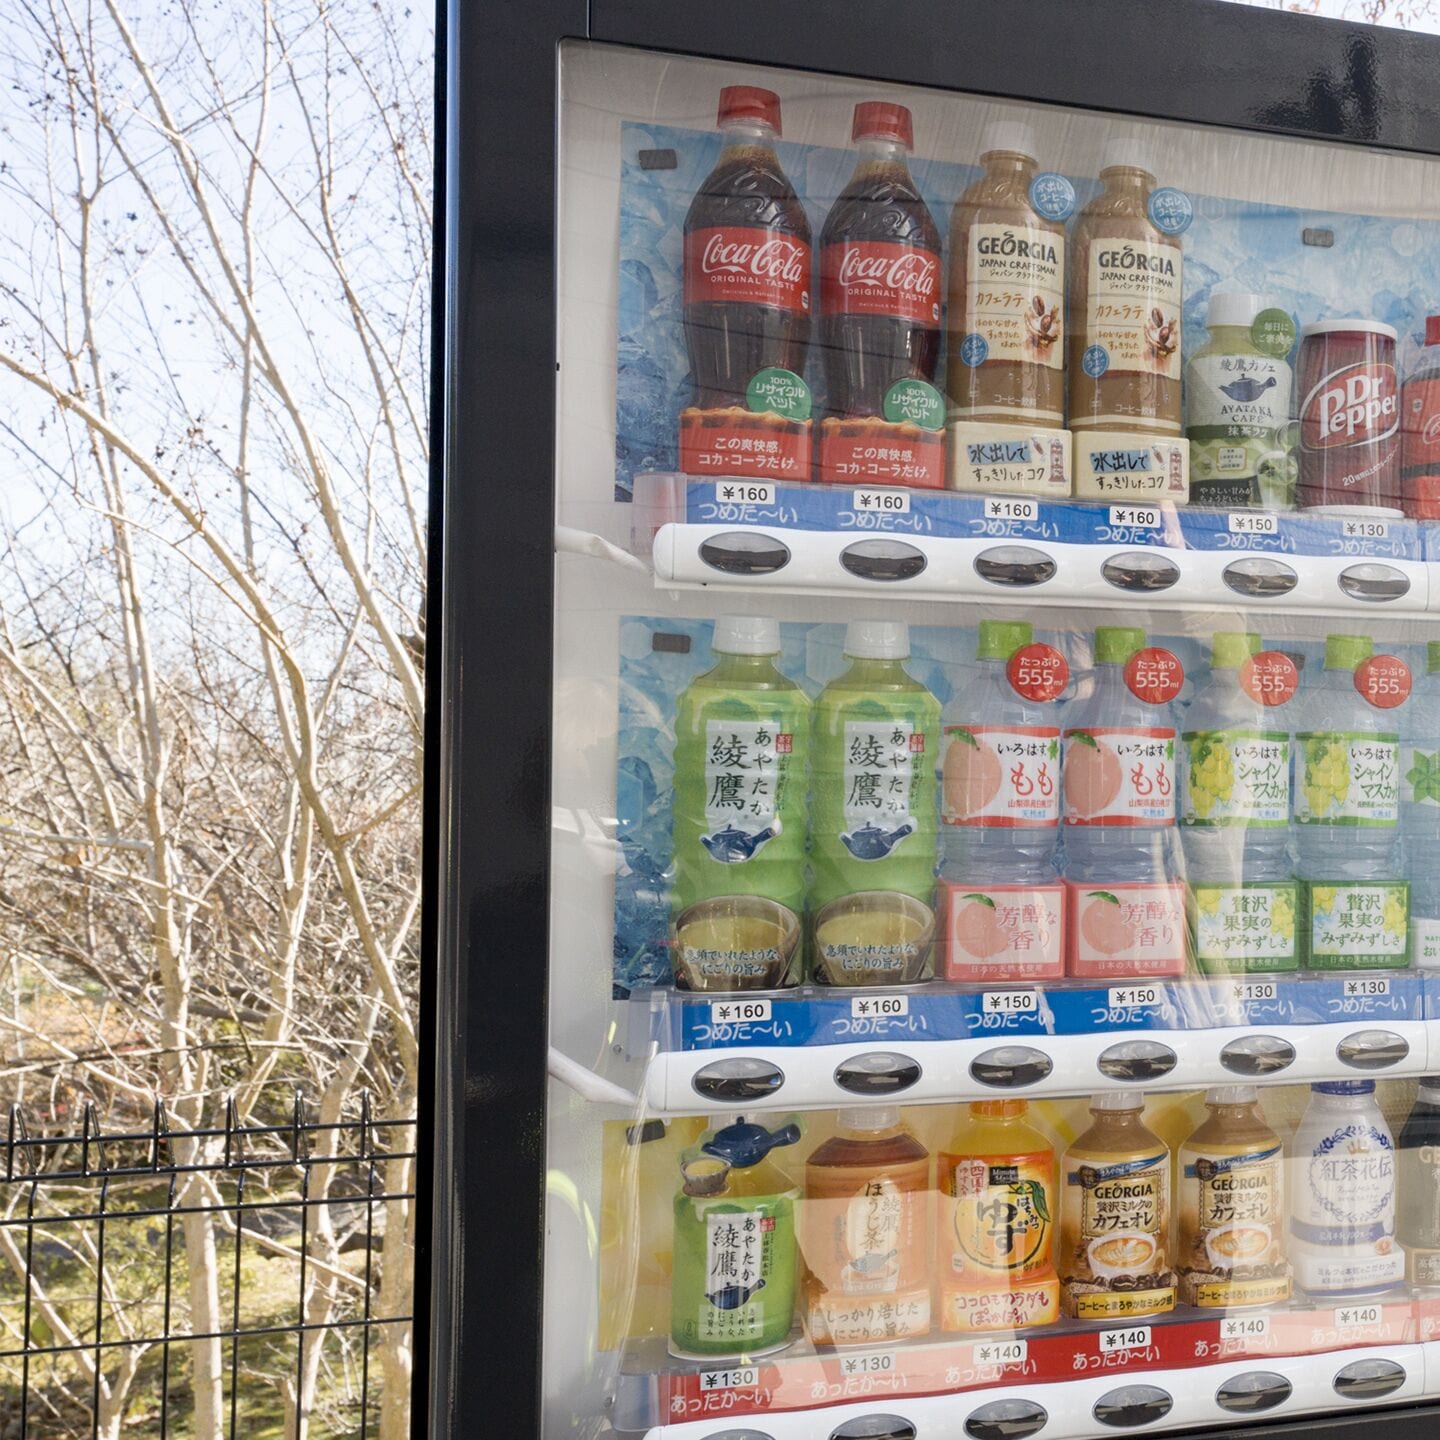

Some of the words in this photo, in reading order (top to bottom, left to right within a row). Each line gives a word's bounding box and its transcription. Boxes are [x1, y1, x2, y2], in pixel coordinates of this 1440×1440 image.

[977, 231, 1059, 265] GEORGIA
[702, 234, 803, 283] Coca-Cola
[978, 258, 1007, 268] JAPAN
[1098, 245, 1176, 278] GEORGIA
[839, 247, 936, 296] Coca-Cola
[1100, 271, 1127, 282] JAPAN
[710, 275, 762, 285] ORIGINAL
[765, 278, 796, 292] TASTE
[847, 288, 896, 298] ORIGINAL
[900, 291, 928, 304] TASTE
[975, 292, 1025, 307] カフェラテ
[1095, 303, 1144, 318] カフェラテ
[755, 382, 806, 398] リサイクル
[769, 377, 792, 387] 100%
[1346, 373, 1384, 405] Dr
[890, 392, 938, 408] リサイクル
[905, 387, 927, 397] 100%
[765, 394, 797, 410] ペット
[900, 405, 931, 420] ペット
[1220, 404, 1274, 419] AYATAKA
[1318, 387, 1397, 442] Pepper
[714, 437, 783, 455] この爽快感。
[851, 446, 917, 463] この爽快感。
[698, 453, 800, 470] コカ・コーラだけ。
[836, 462, 932, 479] コカ・コーラだけ。
[971, 467, 1046, 482] すっきりしたコク
[1095, 475, 1165, 490] すっきりしたコク
[722, 486, 769, 502] ¥160
[859, 494, 904, 510] ¥160
[990, 502, 1032, 518] ¥160
[1115, 510, 1156, 525] ¥160
[1234, 516, 1273, 531] ¥150
[1346, 522, 1385, 537] ¥130
[1019, 656, 1061, 668] たっぷり
[1136, 659, 1177, 670] たっぷり
[1252, 663, 1292, 674] たっぷり
[1368, 666, 1407, 677] たっぷり
[708, 733, 752, 810] 綾鷹
[750, 726, 773, 816] あやたか
[846, 734, 888, 810] 綾鷹
[886, 727, 908, 814] あやたか
[1130, 762, 1172, 796] もも
[1238, 762, 1282, 780] シャイン
[1354, 762, 1394, 781] シャイン
[1009, 762, 1054, 797] もも
[1231, 895, 1269, 913] 贅沢
[1346, 894, 1382, 912] 贅沢
[998, 904, 1058, 930] 芳醇な
[1223, 914, 1273, 932] 果実の
[1338, 912, 1386, 929] 果実の
[1009, 930, 1051, 951] 香り
[1135, 925, 1175, 948] 香り
[1206, 933, 1289, 951] みずみずしさ
[1321, 931, 1401, 947] みずみずしさ
[701, 962, 768, 977] にごりの旨み
[841, 956, 905, 971] にごりの旨み
[1115, 989, 1156, 1003] ¥150
[1233, 985, 1274, 999] ¥130
[1348, 981, 1387, 995] ¥130
[858, 999, 902, 1014] ¥160
[989, 994, 1032, 1009] ¥150
[719, 1004, 765, 1019] ¥160
[1320, 1156, 1393, 1182] 紅茶花伝
[1093, 1182, 1155, 1200] GEORGIA
[1210, 1175, 1269, 1192] GEORGIA
[858, 1181, 885, 1250] ほうじ茶
[1016, 1194, 1041, 1231] はちみつ
[1092, 1210, 1155, 1231] カフェオレ
[1209, 1203, 1270, 1221] カフェオレ
[976, 1198, 1028, 1256] ゆず
[710, 1223, 742, 1278] 綾鷹
[740, 1218, 757, 1282] あやたか
[955, 1291, 1050, 1311] ココロもカラダも
[825, 1301, 920, 1323] しっかり焙じた
[1340, 1308, 1378, 1323] ¥140
[833, 1322, 911, 1340] にごりの旨み
[1226, 1319, 1265, 1334] ¥140
[1105, 1330, 1147, 1348] ¥140
[979, 1345, 1022, 1361] ¥140
[844, 1355, 892, 1373] ¥130
[705, 1370, 754, 1388] ¥130
